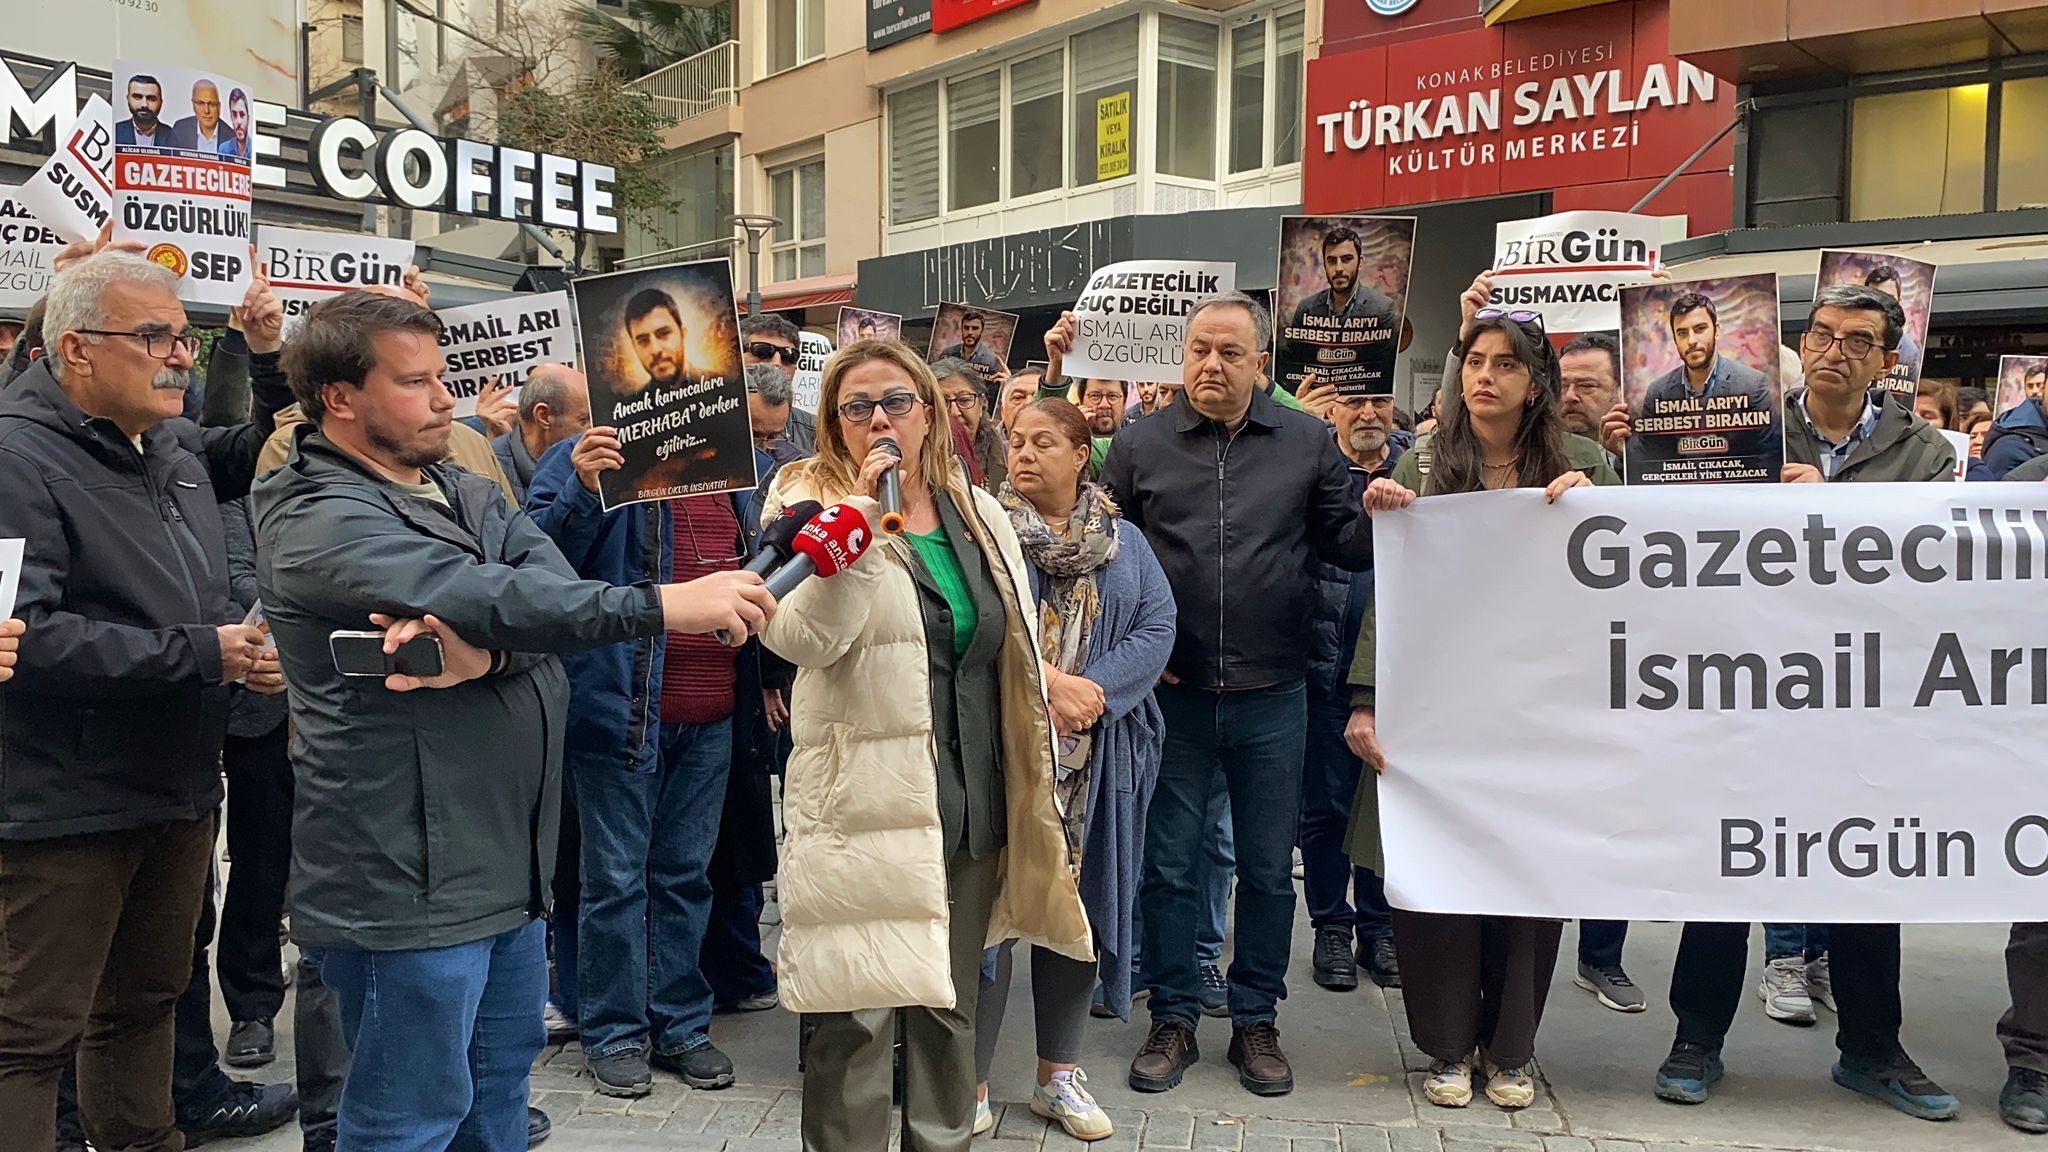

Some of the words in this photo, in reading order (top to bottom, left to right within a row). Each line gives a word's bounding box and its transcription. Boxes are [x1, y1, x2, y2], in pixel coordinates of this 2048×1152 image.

[145, 0, 158, 12] 30
[1416, 65, 1484, 90] KONAK
[1491, 41, 1614, 79] BELEDİYESİ
[1100, 98, 1128, 120] SATILIK
[1317, 88, 1501, 154] TÜRKAN
[1512, 59, 1715, 128] SAYLAN
[1106, 122, 1122, 135] VEYA
[1100, 139, 1127, 159] KİRALIK
[1388, 140, 1496, 176] KÜLTÜR
[1504, 120, 1641, 161] MERKEZİ
[124, 161, 251, 198] GAZETECİLERE
[312, 116, 618, 234] COFFEE
[47, 162, 111, 230] SUSM
[191, 251, 242, 283] SEP
[1091, 269, 1220, 294] GAZETECİLİK
[1077, 294, 1116, 316] SUÇ
[1119, 293, 1197, 317] DEĞİLD
[438, 314, 512, 347] SMAİL
[517, 309, 561, 335] ARI
[1078, 316, 1143, 341] İSMAİL
[1149, 323, 1184, 342] ARI
[1302, 313, 1342, 329] İSMAİL
[1343, 317, 1378, 328] ARI'YI
[1284, 327, 1340, 342] SERBEST
[1341, 328, 1392, 343] BIRAKIN
[446, 336, 553, 373] SERBEST
[1088, 340, 1185, 366] ÖZGÜRLÜ
[1303, 364, 1330, 376] İSMAİL
[1348, 372, 1382, 380] YAZACAK
[612, 391, 654, 420] Ancak
[655, 374, 725, 407] karıncalara
[699, 395, 740, 419] derken
[1655, 396, 1704, 414] İSMAİL
[1706, 395, 1749, 411] ARI'YI
[1634, 415, 1701, 433] SERBEST
[1705, 411, 1771, 429] BIRAKIN
[1641, 469, 1698, 482] GERÇEKLERİ
[1699, 469, 1722, 480] YİNE
[1724, 468, 1768, 479] YAZACAK
[1662, 460, 1697, 471] İSMAİL
[667, 484, 689, 495] OKUR
[828, 539, 848, 570] anka
[1609, 621, 1881, 711] İsmail
[1913, 632, 2047, 707] Arı
[1720, 816, 1976, 878] BirGün
